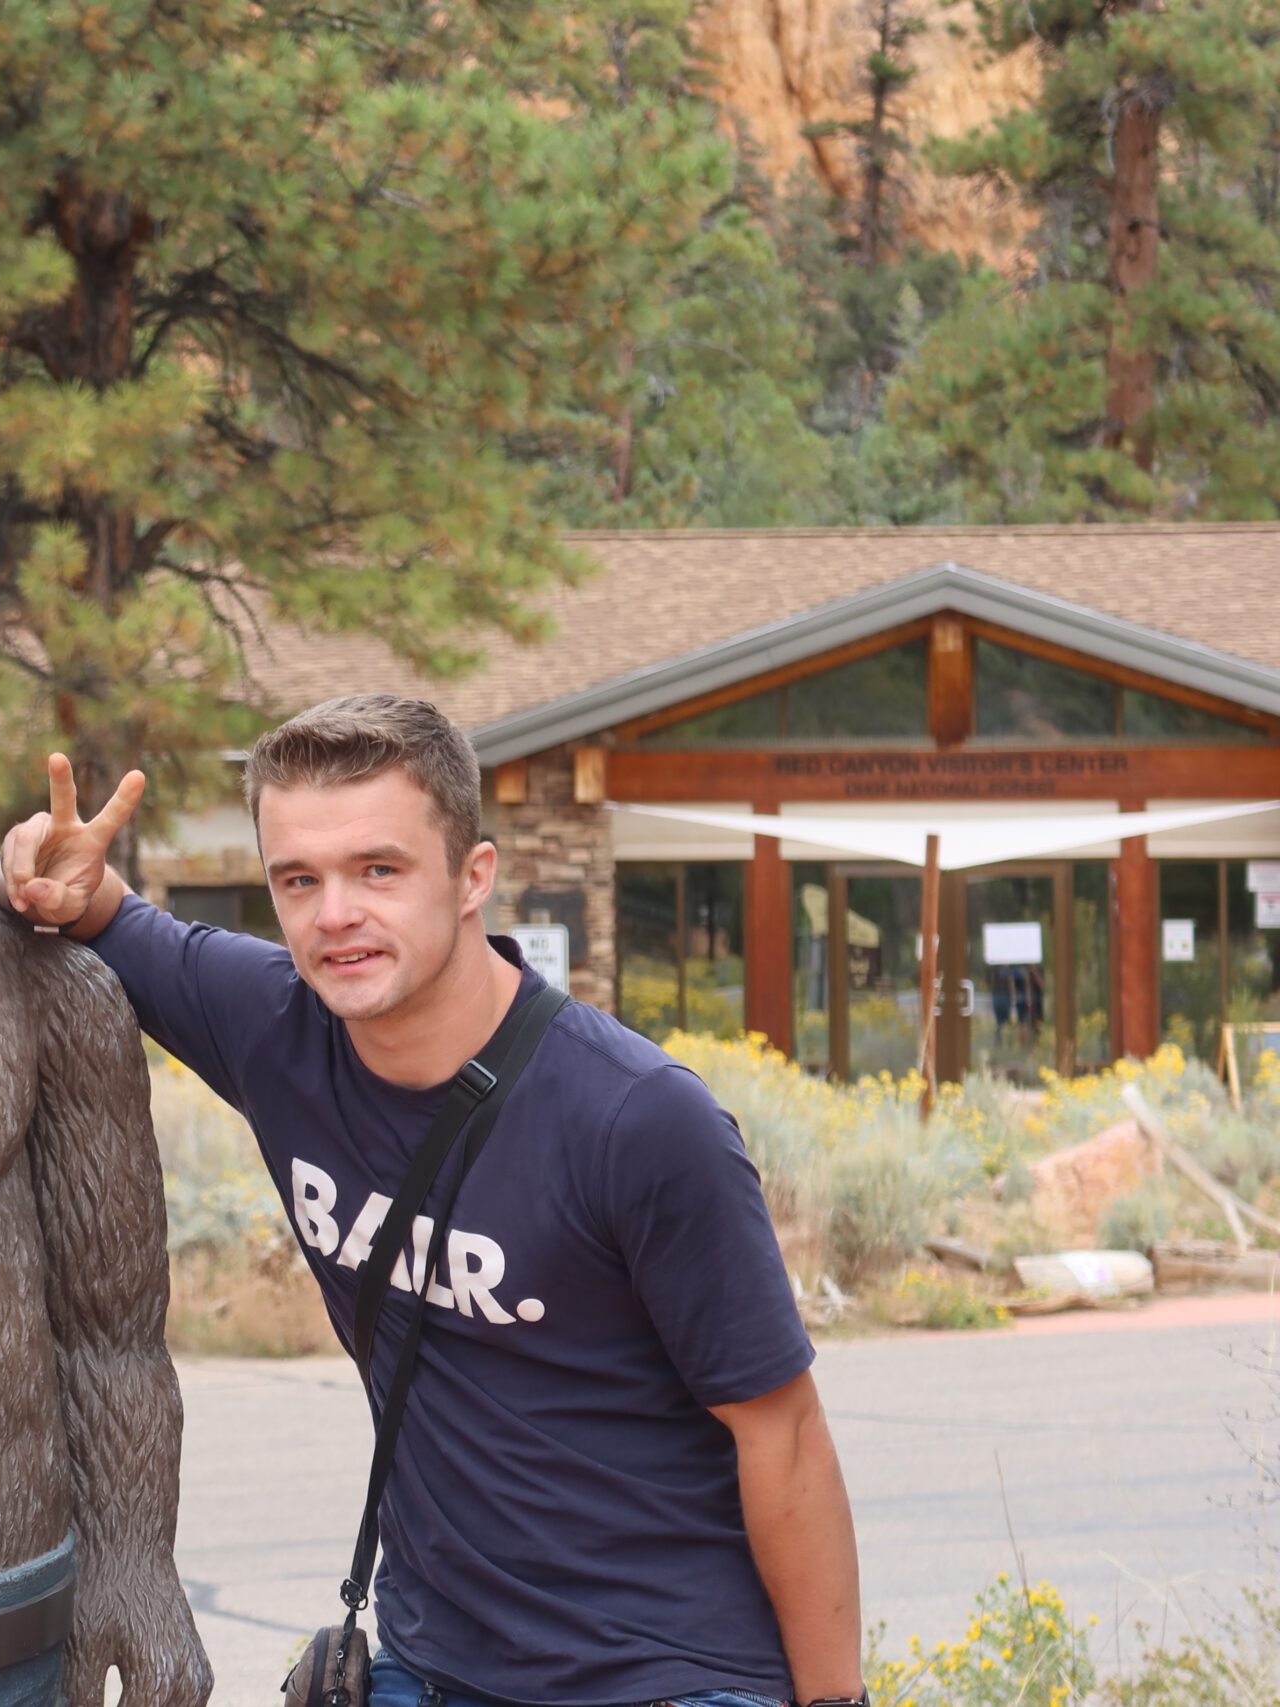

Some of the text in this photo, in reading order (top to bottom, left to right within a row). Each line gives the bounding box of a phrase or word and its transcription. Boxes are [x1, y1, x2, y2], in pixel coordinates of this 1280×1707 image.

[774, 752, 1129, 776] RED CANYON VISITOR'S CENTER
[896, 781, 980, 796] NATIONAL
[988, 780, 1056, 795] FOREST
